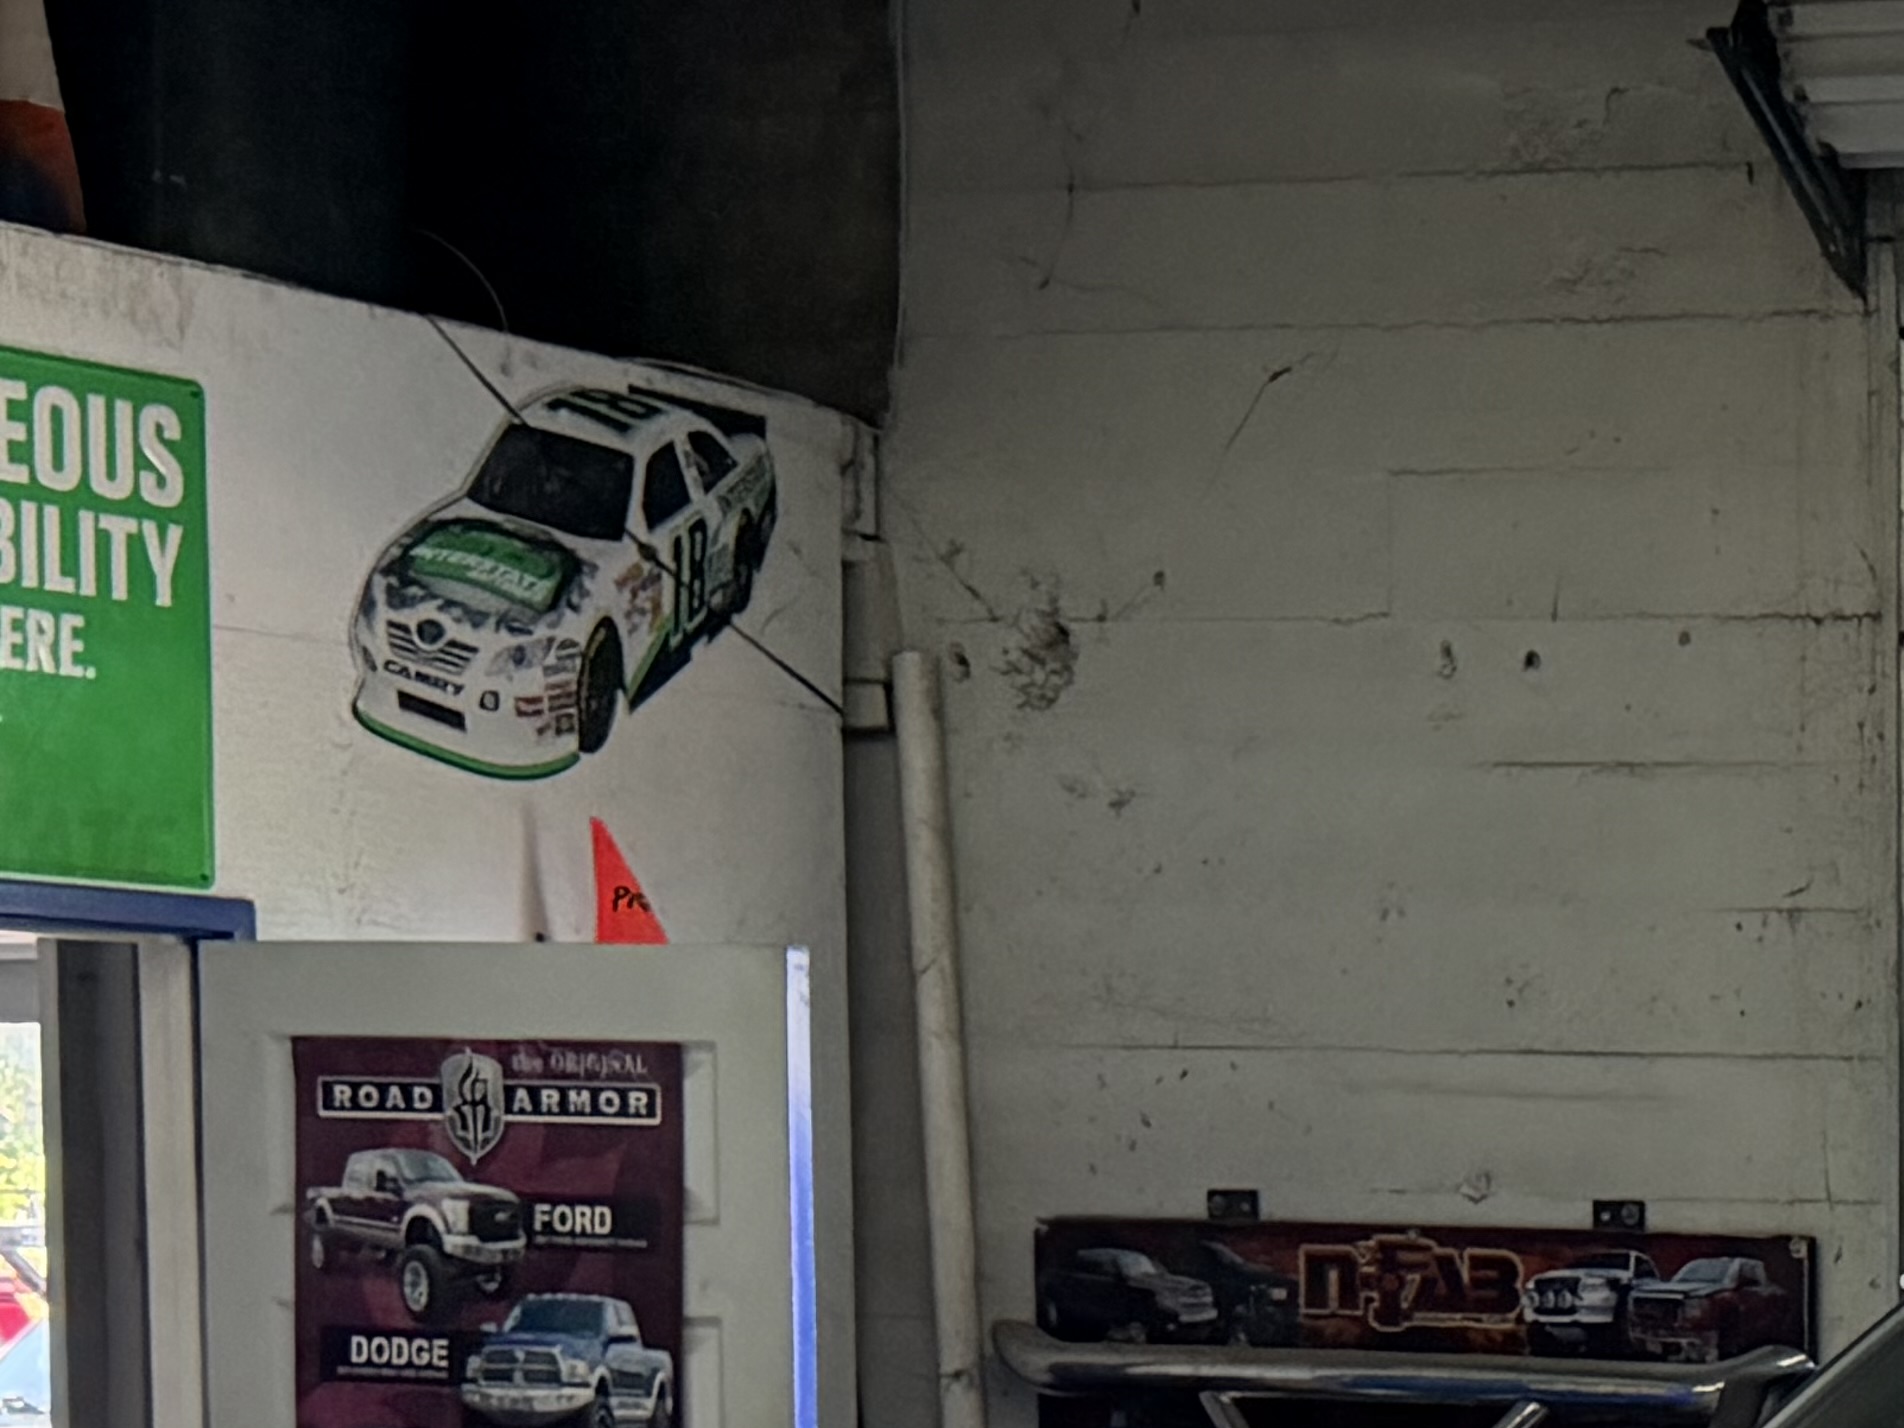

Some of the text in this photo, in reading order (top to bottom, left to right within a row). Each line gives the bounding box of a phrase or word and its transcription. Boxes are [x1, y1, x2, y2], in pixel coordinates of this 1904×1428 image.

[332, 1083, 648, 1115] ROAD ARMOR
[533, 1203, 612, 1235] FORD
[350, 1335, 449, 1368] DODGE
